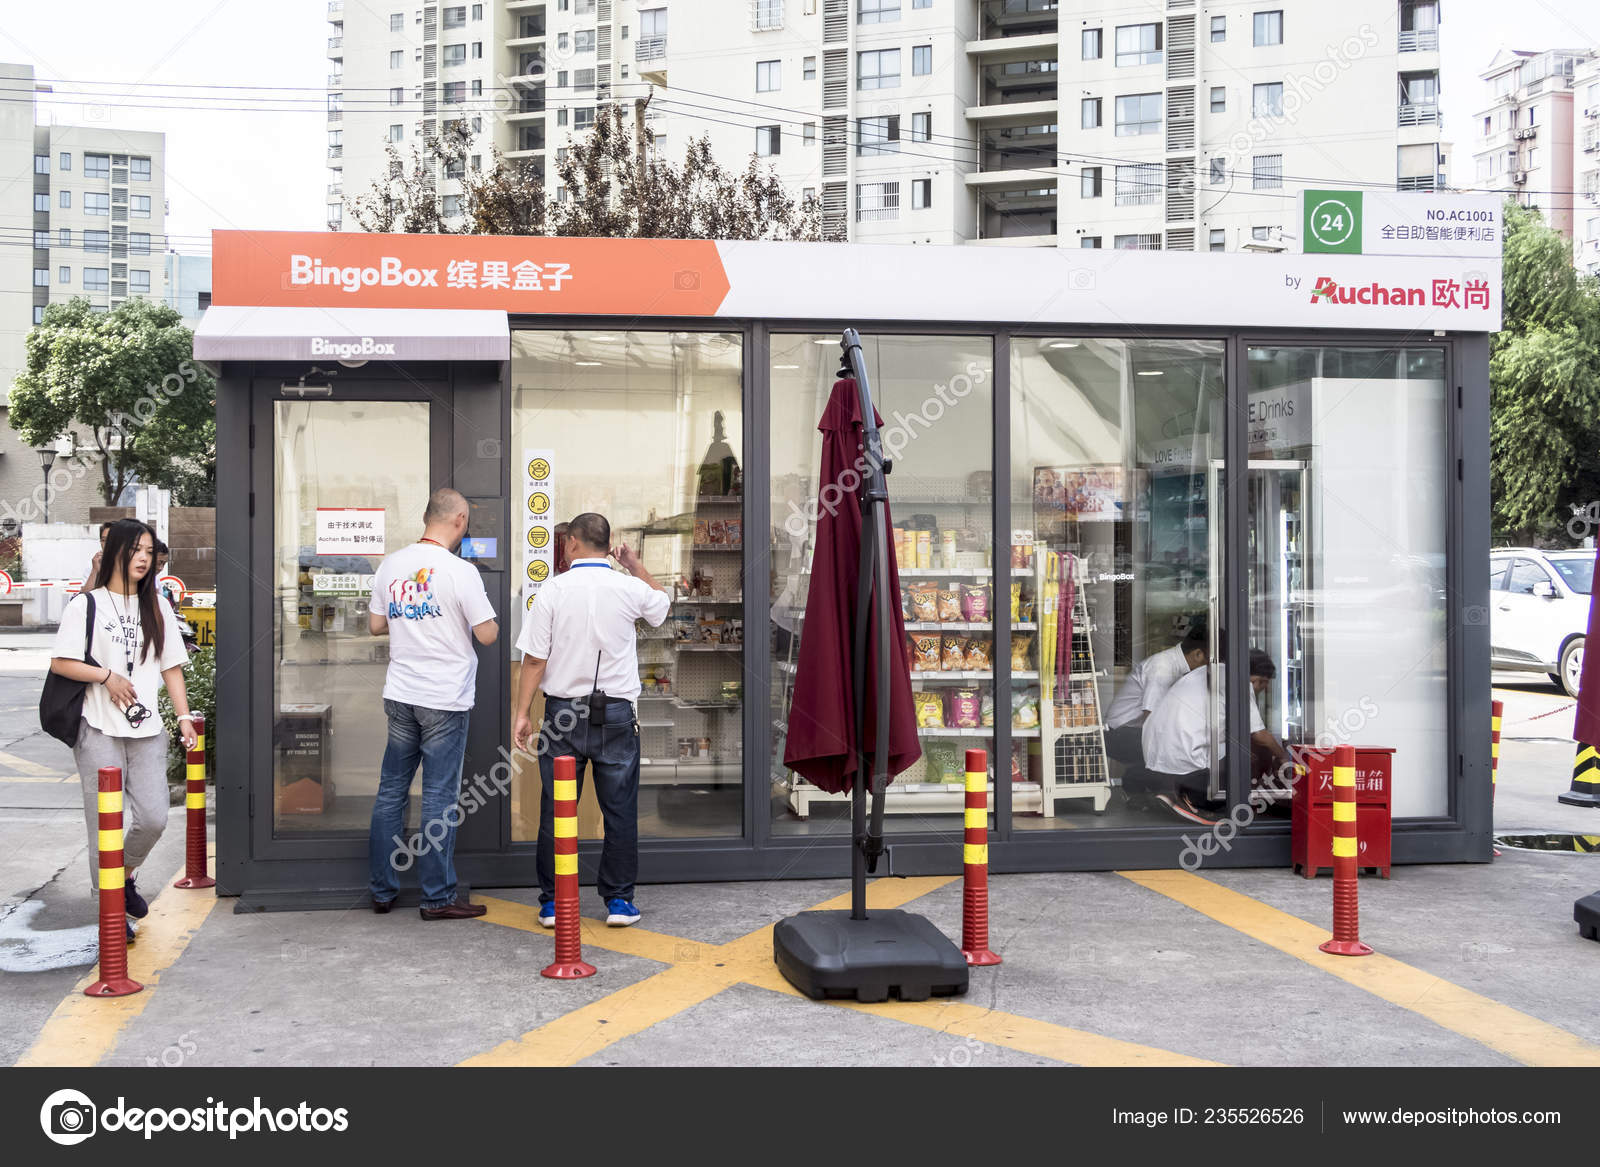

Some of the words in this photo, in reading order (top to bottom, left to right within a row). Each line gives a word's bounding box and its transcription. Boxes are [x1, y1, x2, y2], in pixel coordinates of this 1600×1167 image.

[1320, 214, 1344, 231] 24
[1426, 209, 1494, 222] NO.AC1001
[1381, 224, 1495, 241] 全自助智能便利店
[291, 254, 439, 292] BingoBox
[446, 259, 573, 291] 缤果盒子
[1285, 273, 1301, 290] by
[1311, 277, 1426, 306] Auchan
[1432, 278, 1490, 310] 欧尚
[311, 337, 396, 358] BingoBox
[1259, 398, 1294, 421] Drinks
[1154, 449, 1173, 463] LOVE
[328, 521, 373, 529] 由于技术调试
[353, 535, 384, 543] 暂时停运
[1099, 573, 1135, 582] BingoBox
[389, 579, 417, 603] 18
[1319, 770, 1384, 791] 灭器箱
